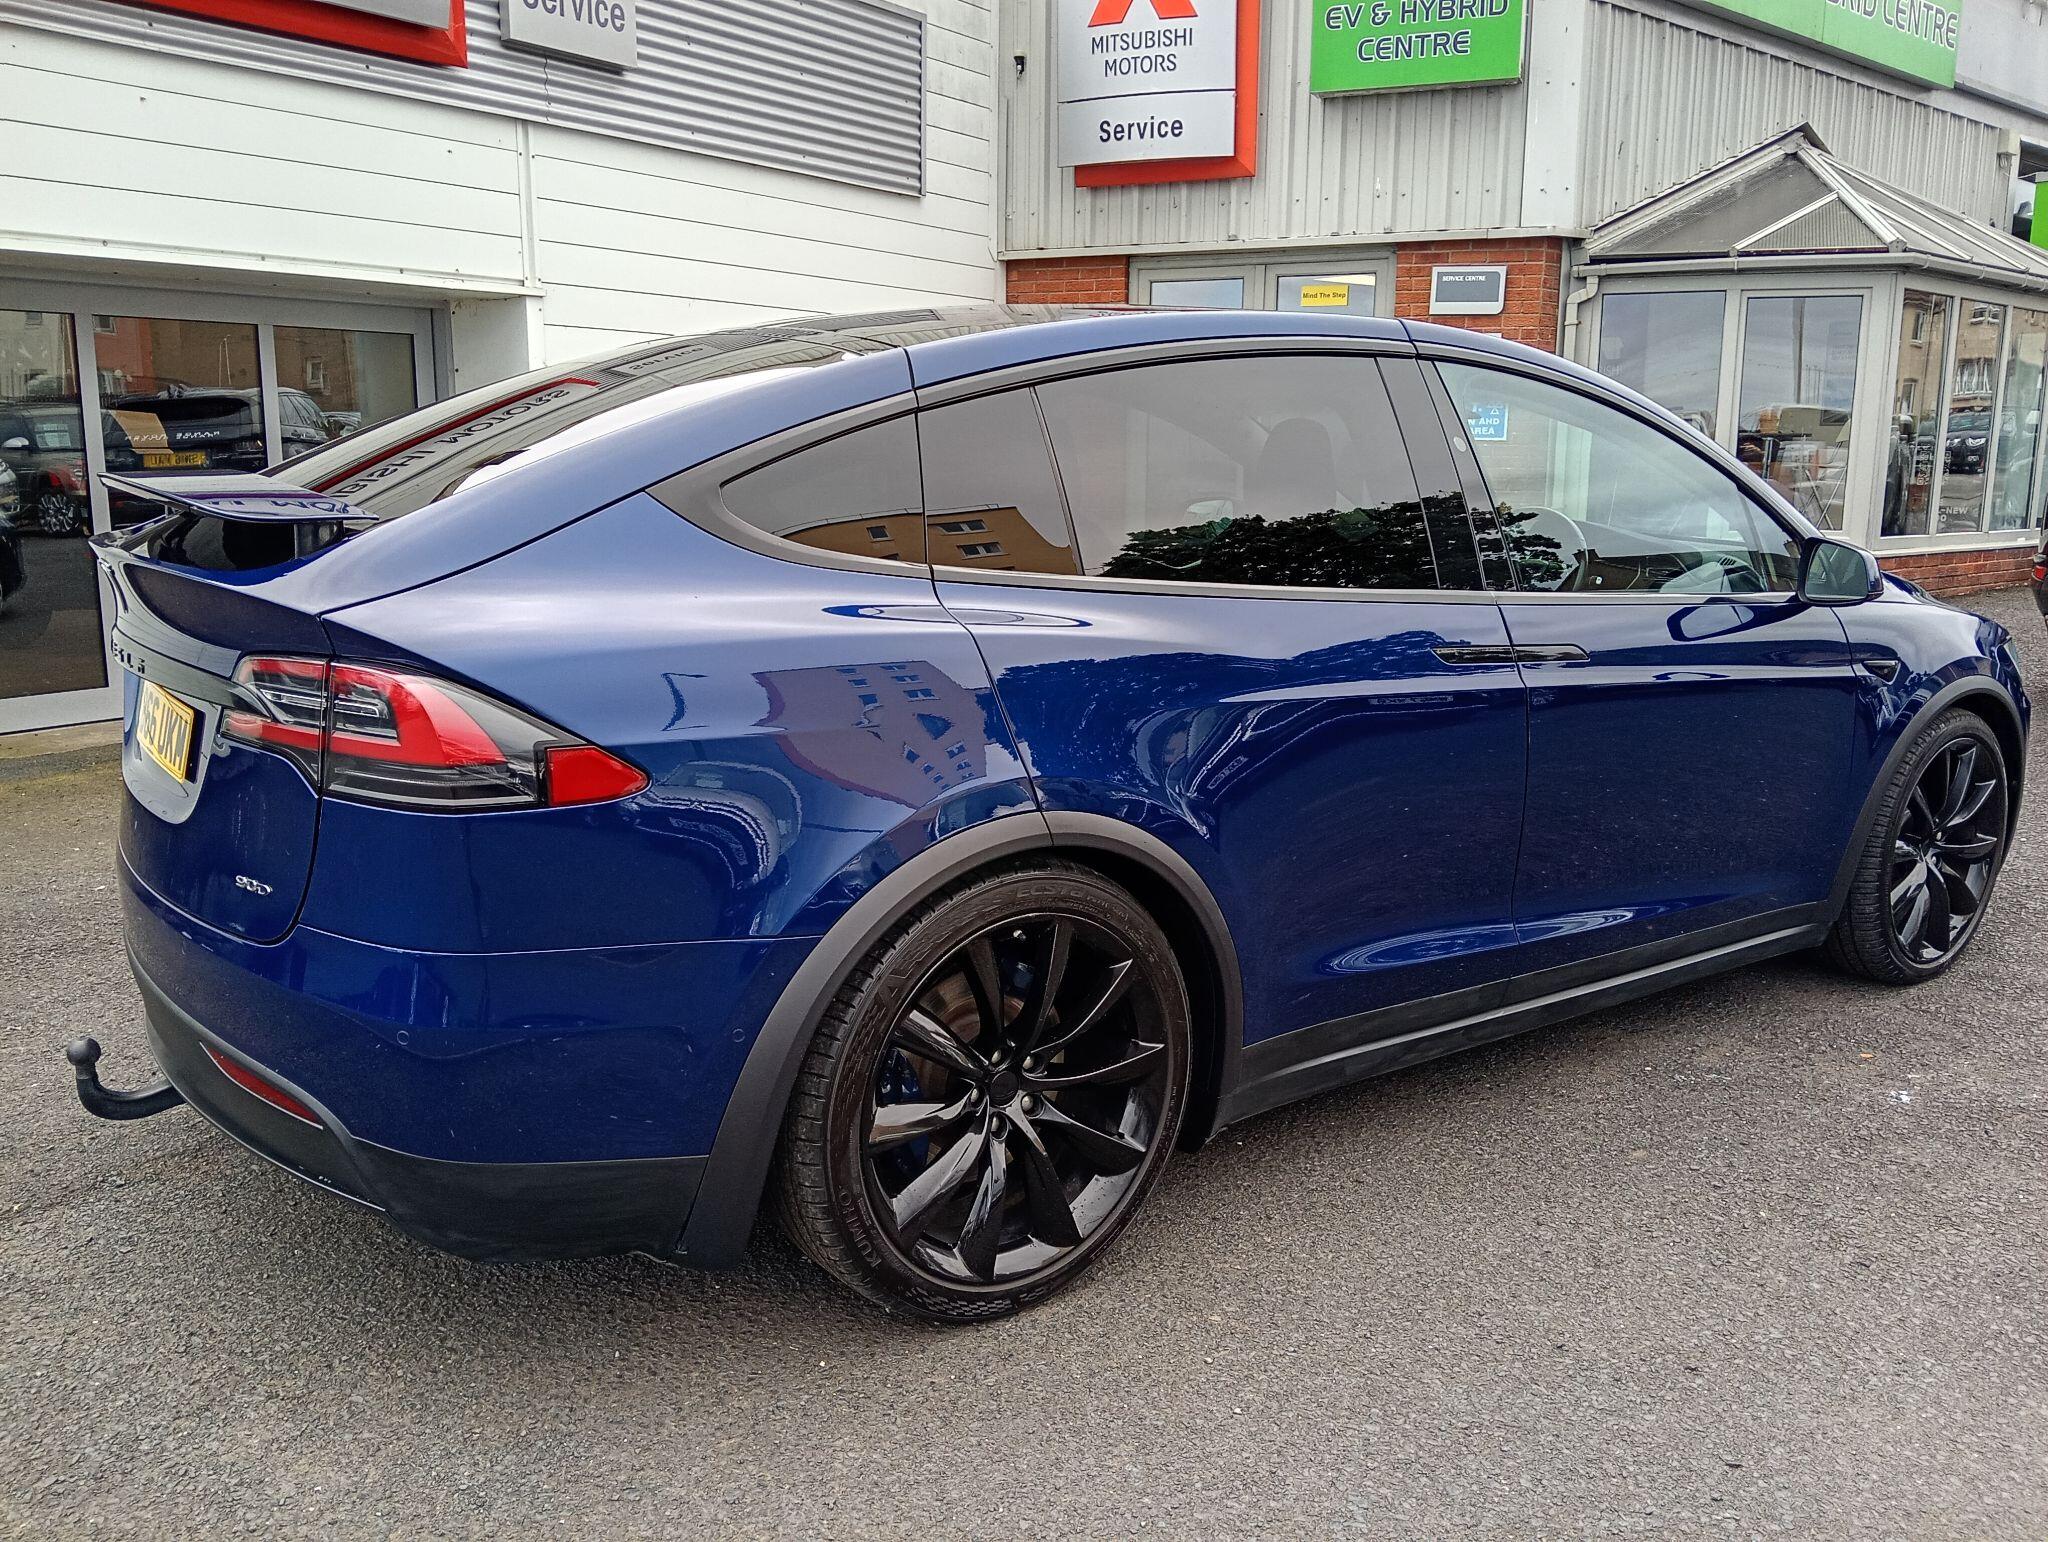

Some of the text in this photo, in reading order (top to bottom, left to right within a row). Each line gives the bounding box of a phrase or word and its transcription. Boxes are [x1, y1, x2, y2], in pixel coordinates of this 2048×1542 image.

[523, 0, 625, 32] ervice
[1325, 0, 1509, 30] EV & HYBRID
[1882, 0, 1958, 50] CENTRE
[1091, 27, 1193, 54] MITSUBISHI
[1357, 30, 1471, 62] CENTRE
[1104, 53, 1177, 77] MOTORS
[1099, 116, 1183, 142] Service
[1479, 417, 1500, 425] AND
[235, 875, 273, 896] 90D
